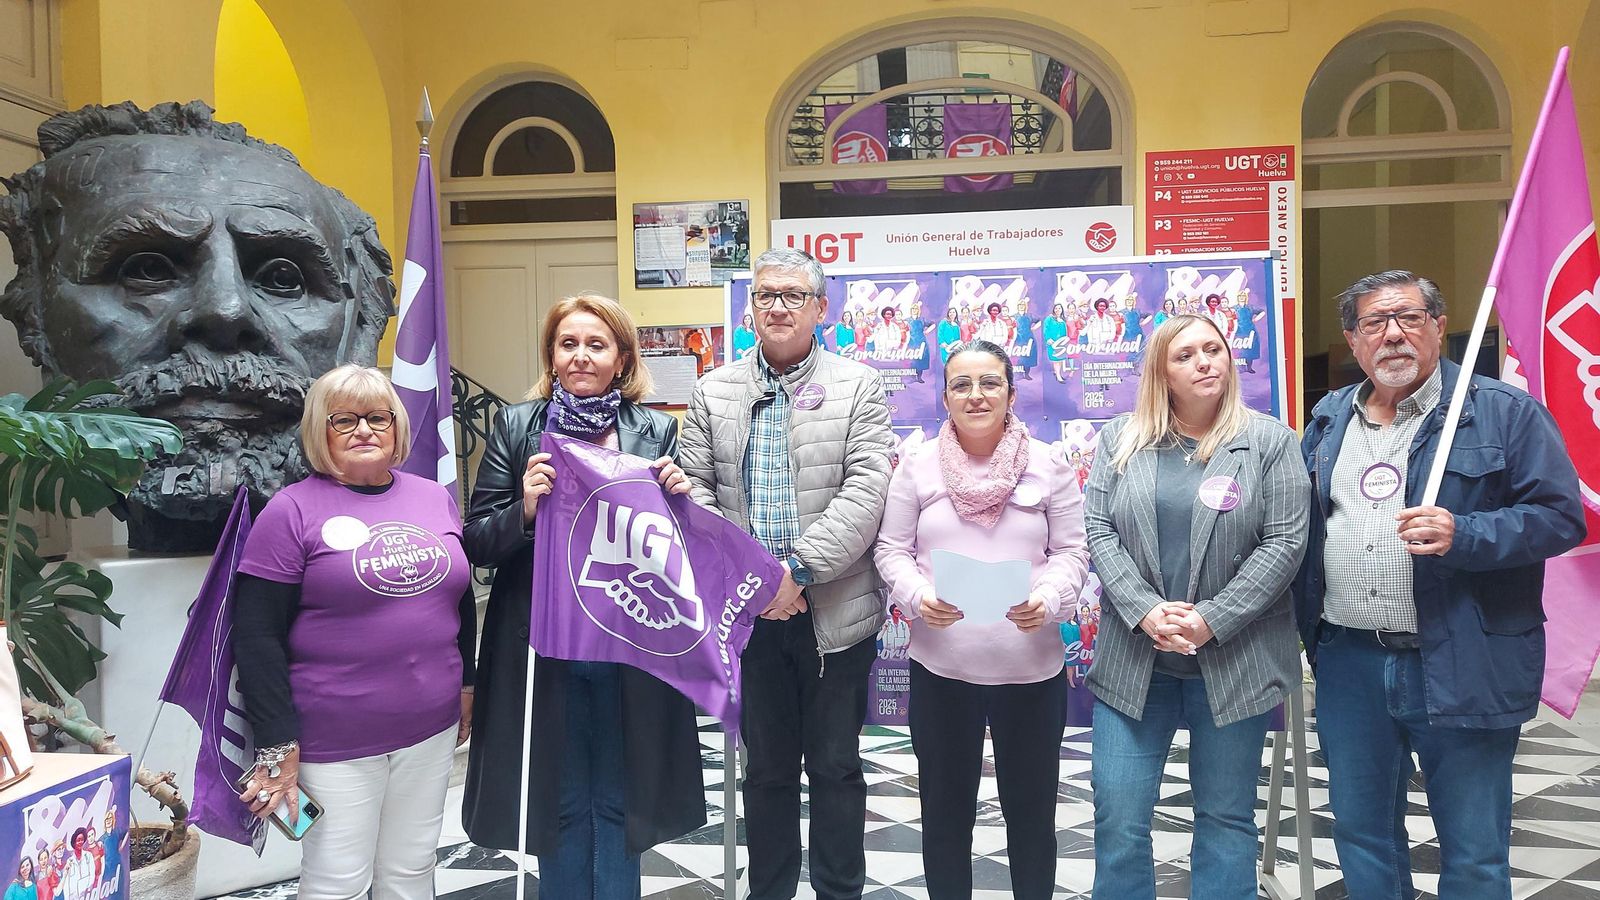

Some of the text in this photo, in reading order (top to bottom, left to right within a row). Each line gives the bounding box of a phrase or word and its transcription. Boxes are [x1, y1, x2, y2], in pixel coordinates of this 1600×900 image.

[1225, 155, 1261, 170] UGT
[1258, 169, 1287, 177] Huelva
[1155, 191, 1172, 201] P4
[1278, 187, 1287, 230] ANEXO
[1155, 220, 1172, 230] P3
[886, 227, 1064, 243] Unión General de Trabajadores
[949, 245, 990, 257] Huelva
[1051, 333, 1142, 357] Sororidad
[840, 342, 926, 360] Sororidad
[1093, 361, 1135, 369] INTERNACIONAL
[880, 368, 918, 376] NTERNACIONAL
[1084, 377, 1122, 385] TRABAJADORA
[1085, 391, 1104, 400] 2025
[1085, 399, 1105, 408] UGT
[1365, 479, 1397, 488] FEMINISTA
[382, 534, 409, 546] UGT
[382, 543, 418, 555] Huelva
[360, 546, 447, 574] FEMINISTA
[421, 572, 442, 588] IGUALDAD
[878, 667, 910, 676] DÍA INTERNA
[878, 676, 910, 684] DE LA MUJER
[879, 684, 910, 692] TRABAJADOR
[879, 698, 897, 707] 2025
[879, 706, 898, 715] UGT
